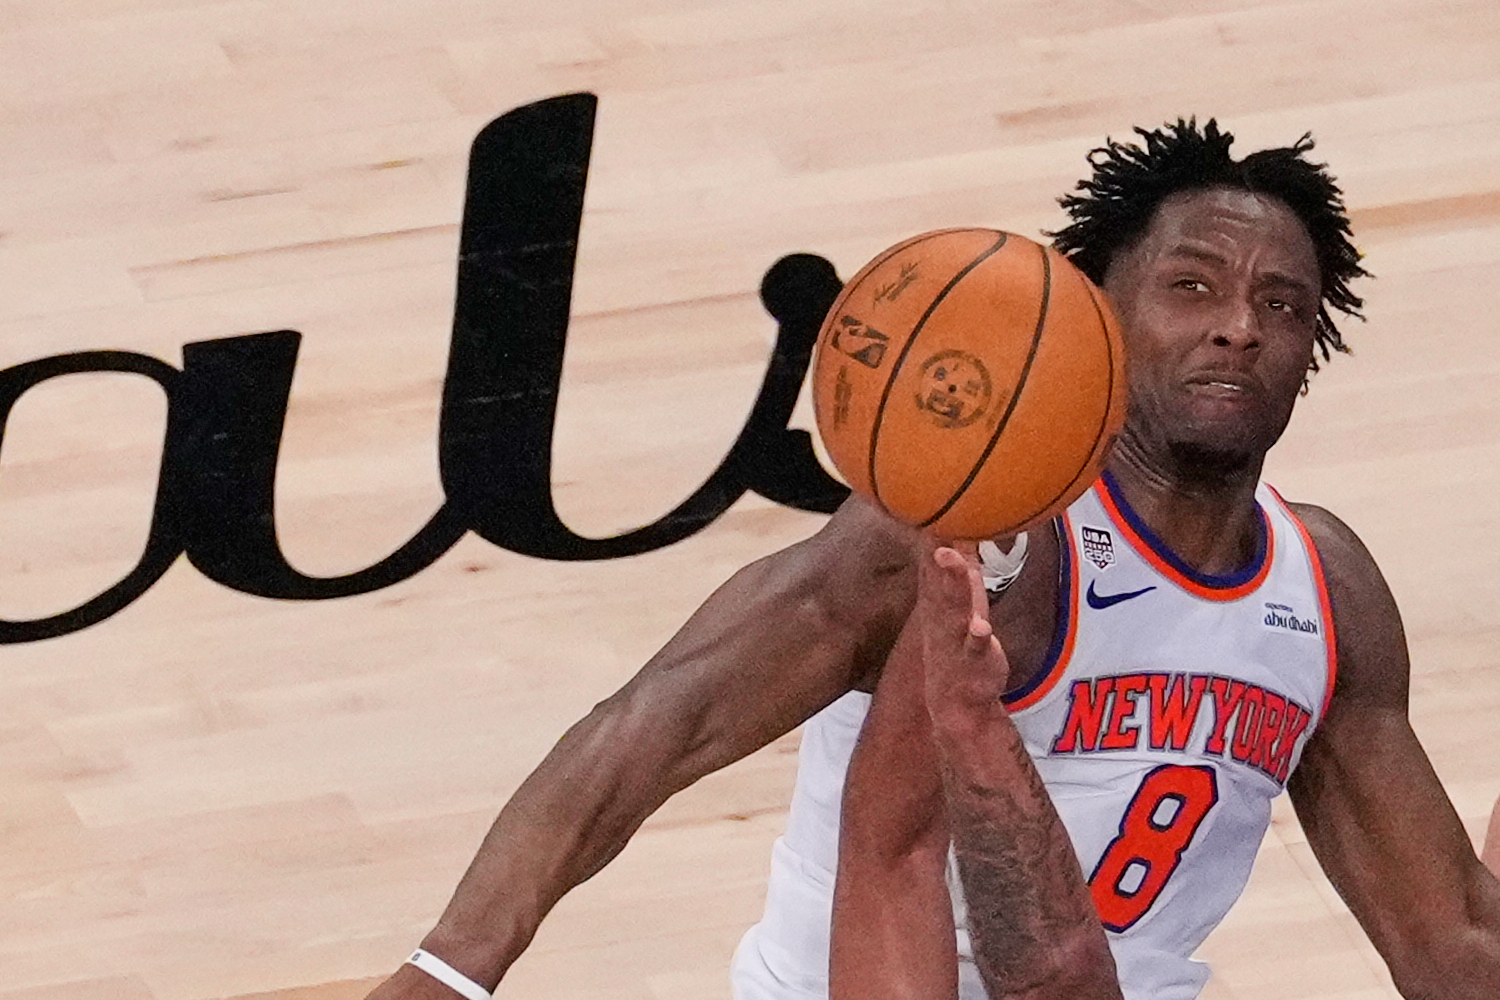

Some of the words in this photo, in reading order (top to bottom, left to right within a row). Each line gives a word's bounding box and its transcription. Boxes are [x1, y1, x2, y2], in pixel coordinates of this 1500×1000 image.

[1048, 670, 1210, 757] NEW
[1202, 676, 1314, 788] YORK
[1086, 763, 1219, 934] 8
